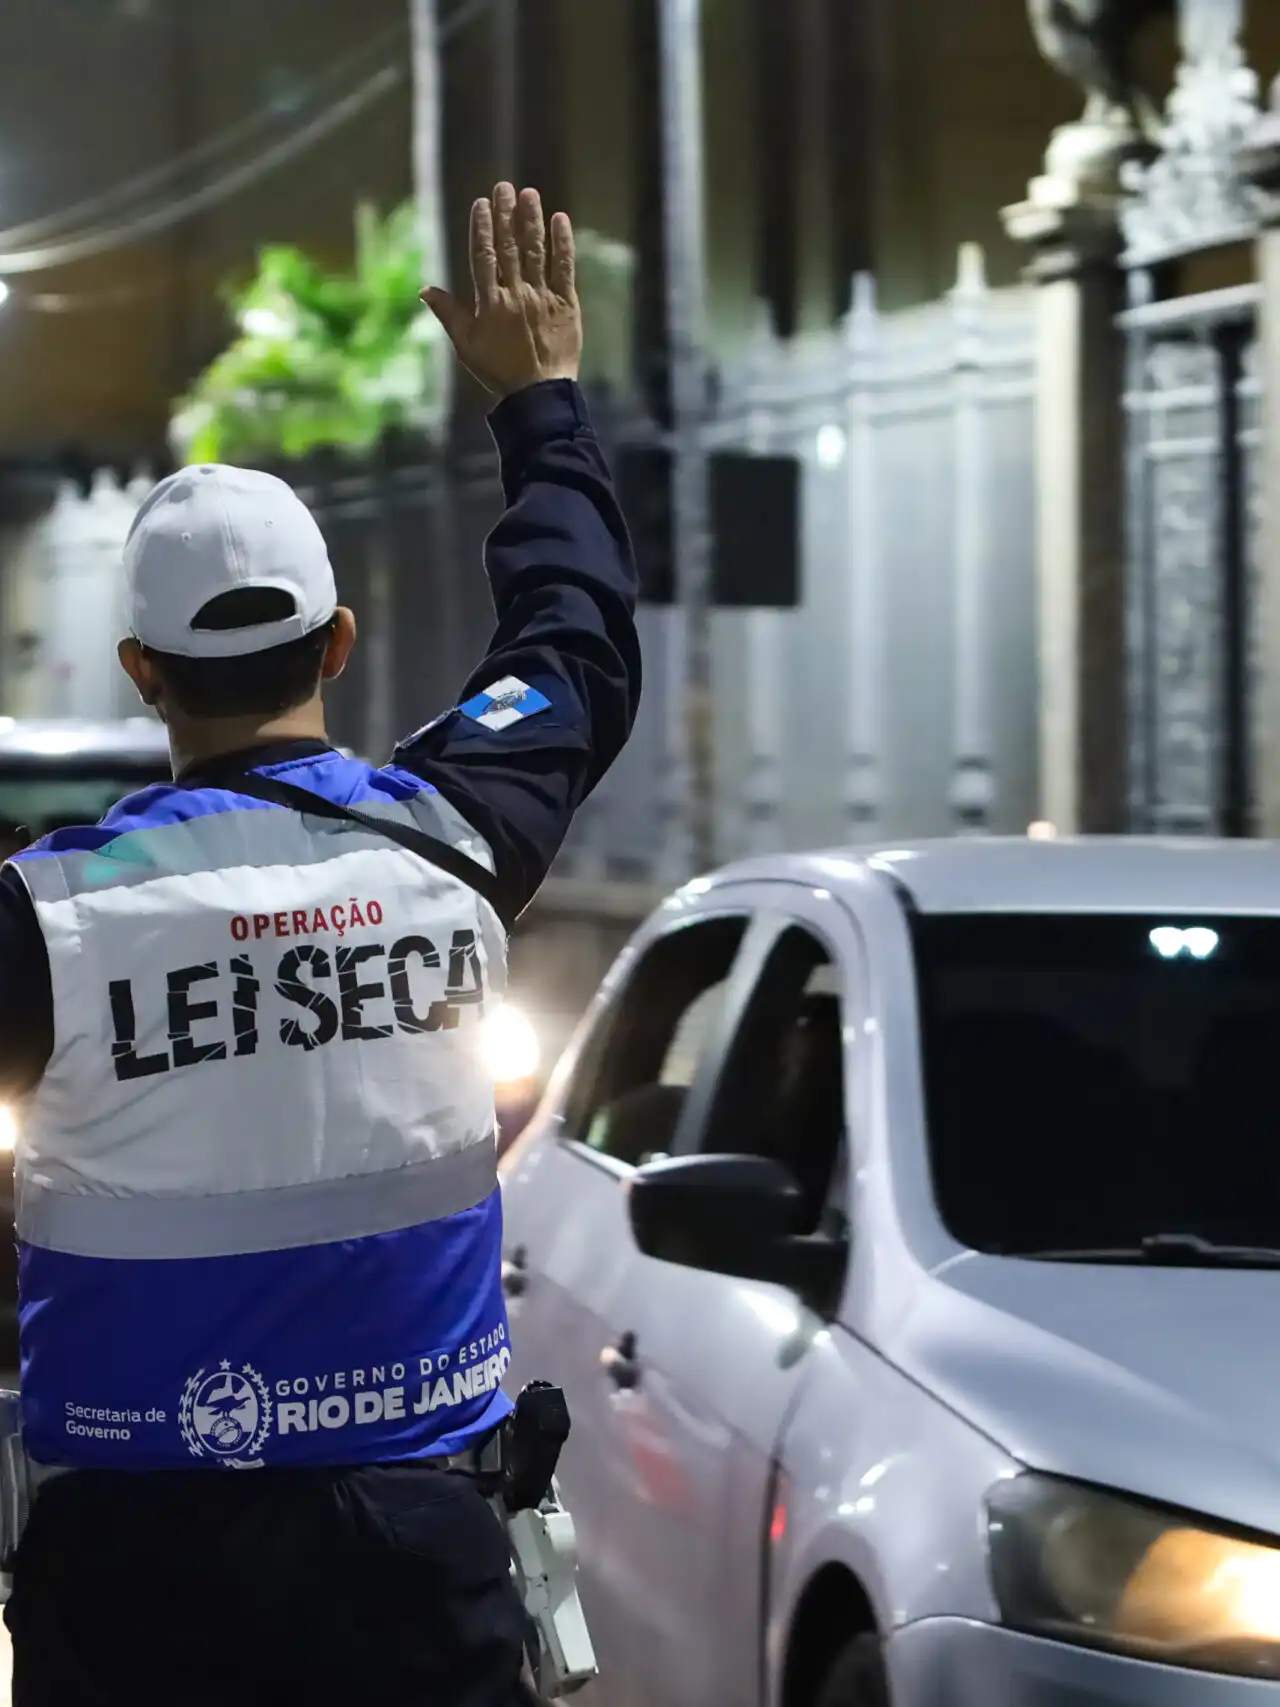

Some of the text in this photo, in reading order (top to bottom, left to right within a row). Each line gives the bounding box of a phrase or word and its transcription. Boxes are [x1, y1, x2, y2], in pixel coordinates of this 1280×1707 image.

[230, 897, 384, 942] OPERAÇÃO
[108, 929, 484, 1082] LEI SECA
[275, 1322, 506, 1396] GOVERNO DO ESTADO
[64, 1401, 167, 1423] Secretaria de
[276, 1394, 350, 1435] RIO
[354, 1386, 406, 1425] DE
[412, 1346, 512, 1415] JANEIRO
[65, 1420, 131, 1441] Governo
